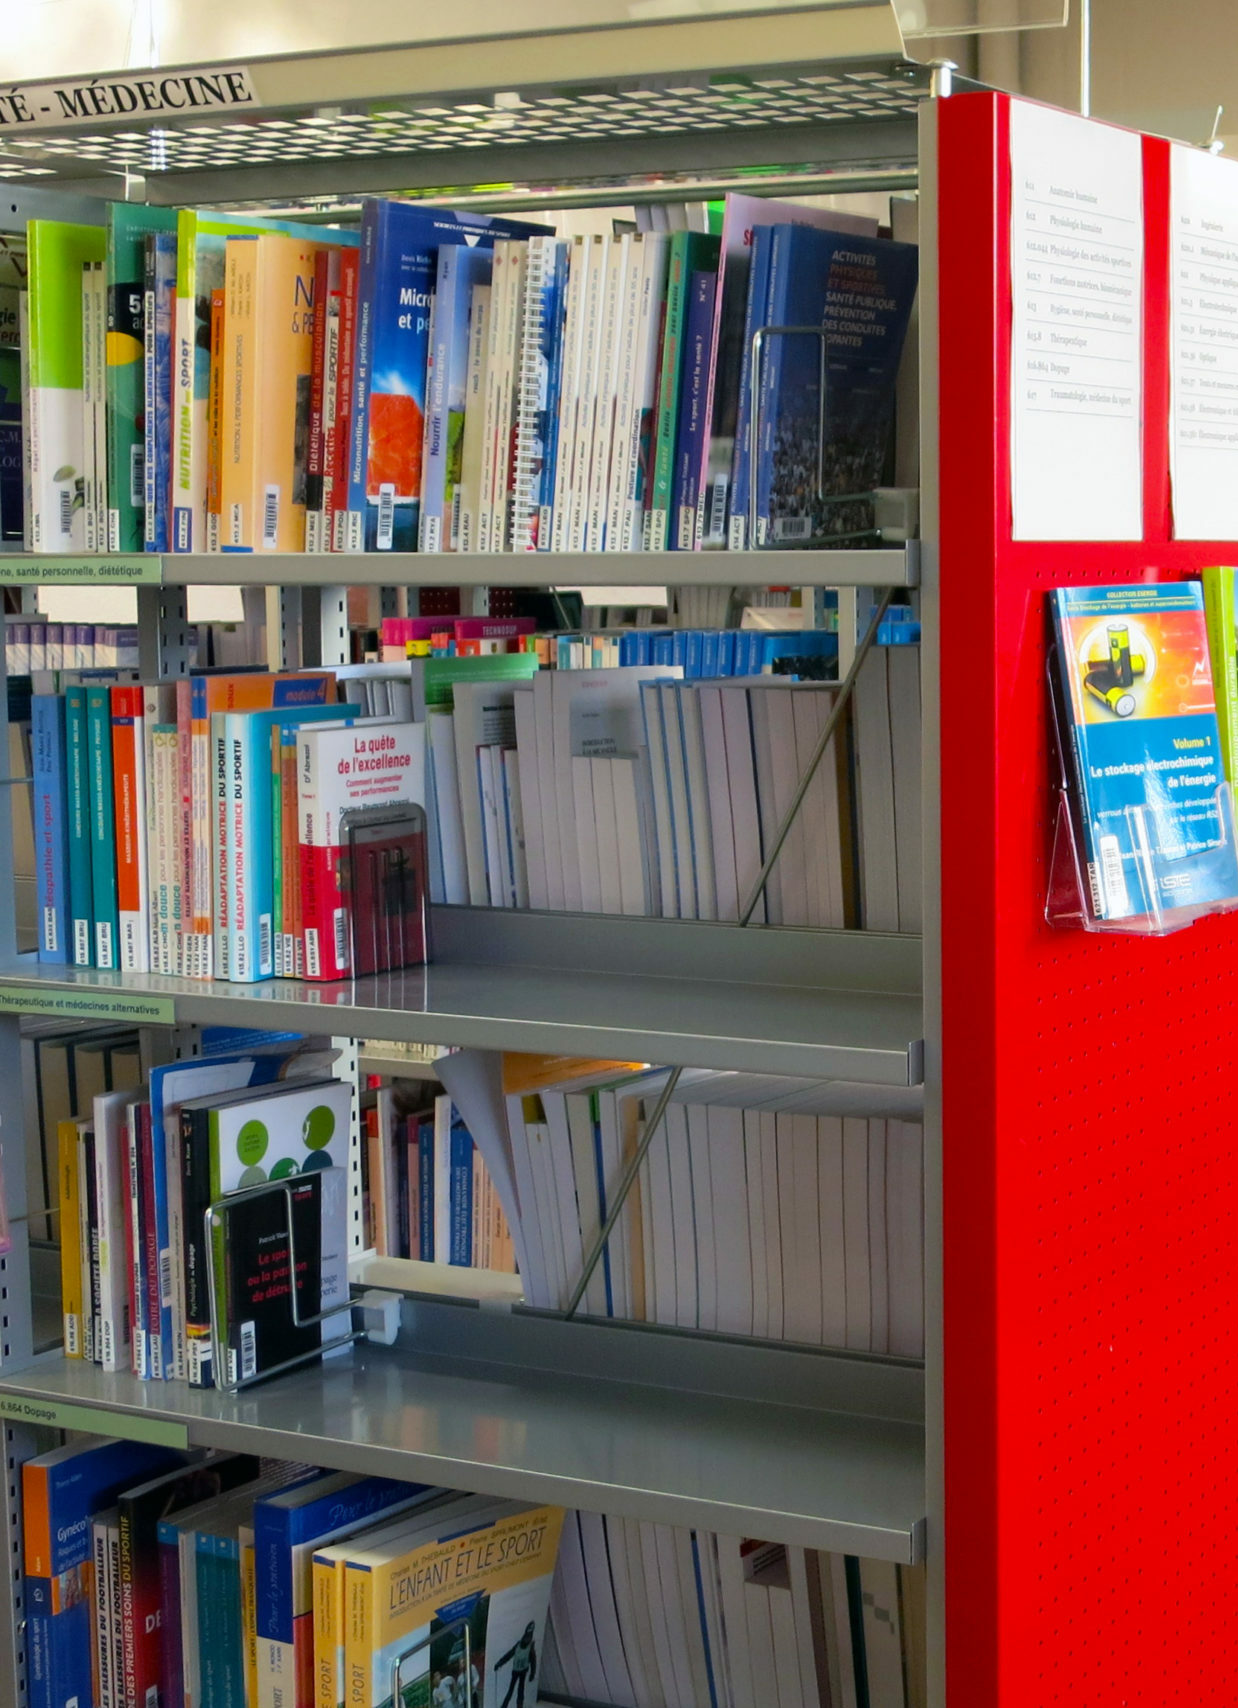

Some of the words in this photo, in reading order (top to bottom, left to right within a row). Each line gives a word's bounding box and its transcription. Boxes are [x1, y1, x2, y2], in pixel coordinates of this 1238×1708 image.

[54, 78, 253, 119] MÉDECINE
[832, 250, 877, 266] ACTIVITÉS
[824, 304, 876, 321] PRÉVENTION
[825, 290, 854, 305] SANTÉ
[359, 302, 370, 364] performance
[398, 313, 412, 329] et
[822, 318, 838, 331] DES
[839, 321, 887, 336] CONDUITES
[180, 338, 192, 388] SPORT
[328, 328, 338, 382] SPORTIF
[313, 378, 321, 389] la
[358, 368, 366, 377] et
[430, 343, 446, 411] l'endurance
[313, 391, 321, 408] de
[356, 381, 365, 408] santé
[179, 405, 191, 490] NUTRITION
[309, 412, 320, 471] Diététique
[430, 416, 442, 456] Nourrir
[630, 409, 641, 458] coordination
[629, 460, 636, 469] et
[626, 470, 636, 500] Posture
[16, 566, 40, 577] santé
[42, 566, 96, 578] personnelle,
[99, 565, 143, 578] diététique
[1227, 656, 1238, 699] durable
[217, 737, 226, 779] SPORTIF
[354, 737, 366, 753] La
[368, 734, 396, 755] quête
[1173, 736, 1205, 750] Volume
[1205, 735, 1212, 747] 1
[233, 738, 242, 780] SPORTIF
[337, 758, 350, 774] de
[352, 753, 412, 773] l'excellence
[1090, 765, 1103, 779] Le
[1104, 762, 1145, 778] stockage
[1145, 754, 1215, 772] électrochimique
[217, 782, 226, 797] DU
[234, 783, 242, 799] DU
[1167, 775, 1179, 789] de
[1179, 771, 1217, 788] l'énergie
[156, 805, 167, 847] personnes
[218, 801, 227, 847] MOTRICE
[234, 803, 243, 849] MOTRICE
[1088, 863, 1097, 880] TAR
[158, 884, 168, 919] douce
[171, 885, 181, 920] douce
[218, 849, 229, 928] RÉADAPTATION
[233, 852, 245, 931] RÉADAPTATION
[56, 1000, 64, 1008] et
[66, 1000, 109, 1011] médecines
[112, 1003, 160, 1015] alternatives
[147, 1232, 157, 1276] DOPAGE
[187, 1244, 196, 1269] dopage
[258, 1253, 269, 1266] Le
[270, 1249, 294, 1263] spo
[149, 1281, 158, 1297] DU
[247, 1275, 261, 1288] ou
[261, 1270, 271, 1283] la
[251, 1290, 265, 1303] de
[265, 1280, 305, 1300] détrue
[187, 1278, 197, 1317] Psychologie
[24, 1405, 57, 1421] Dopage
[119, 1516, 131, 1562] SPORTIF
[96, 1538, 106, 1612] FOOTBALLEUR
[111, 1542, 121, 1616] FOOTBALLEUR
[121, 1563, 132, 1582] DU
[268, 1543, 283, 1591] praticien
[390, 1555, 453, 1610] L'ENFANT
[455, 1549, 475, 1578] ET
[476, 1542, 496, 1570] LE
[496, 1524, 549, 1563] SPORT
[122, 1583, 133, 1617] SOINS
[98, 1615, 106, 1631] DU
[114, 1620, 122, 1635] DU
[267, 1604, 279, 1633] Pour
[123, 1619, 134, 1674] PREMIERS
[100, 1635, 109, 1691] BLESSURES
[115, 1640, 124, 1696] BLESSURES
[319, 1658, 332, 1698] SPORT
[125, 1675, 136, 1697] DES
[350, 1663, 364, 1704] SPORT
